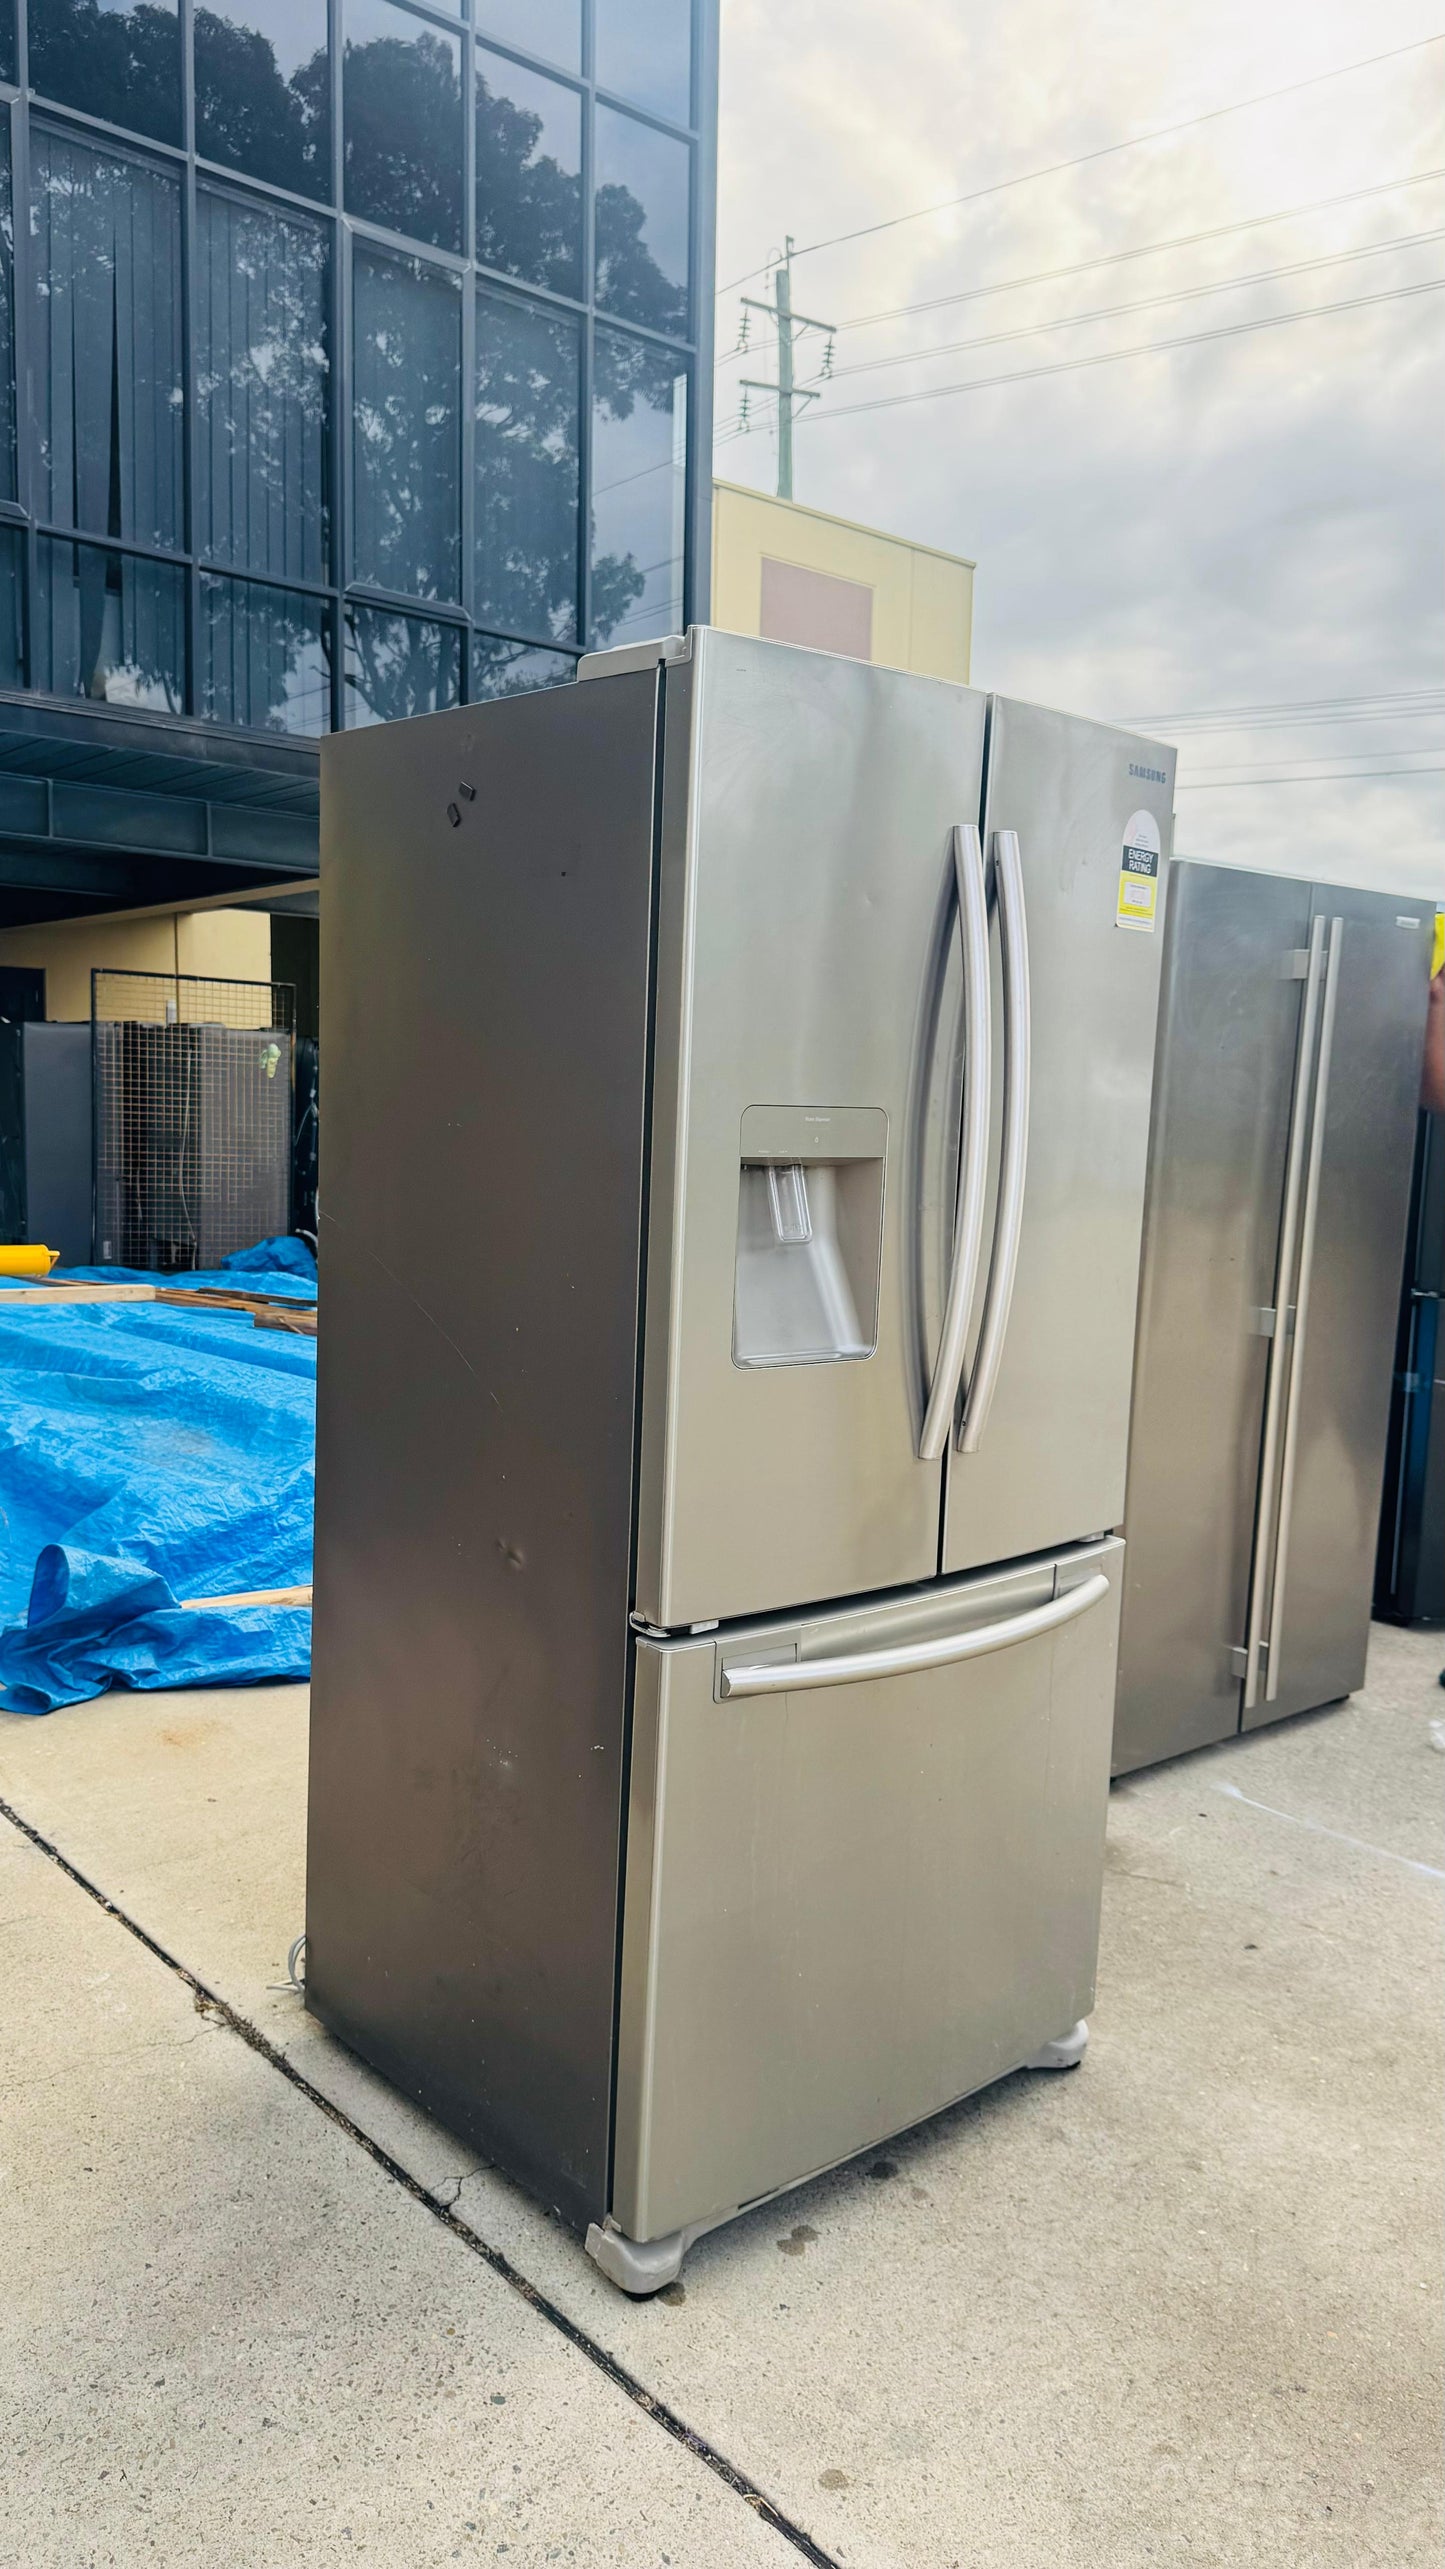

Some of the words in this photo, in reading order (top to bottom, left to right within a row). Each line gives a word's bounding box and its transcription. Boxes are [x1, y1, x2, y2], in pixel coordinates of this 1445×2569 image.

[1129, 763, 1166, 784] SAMSUNG
[1128, 848, 1154, 864] ENERGY
[1128, 860, 1151, 874] RATING
